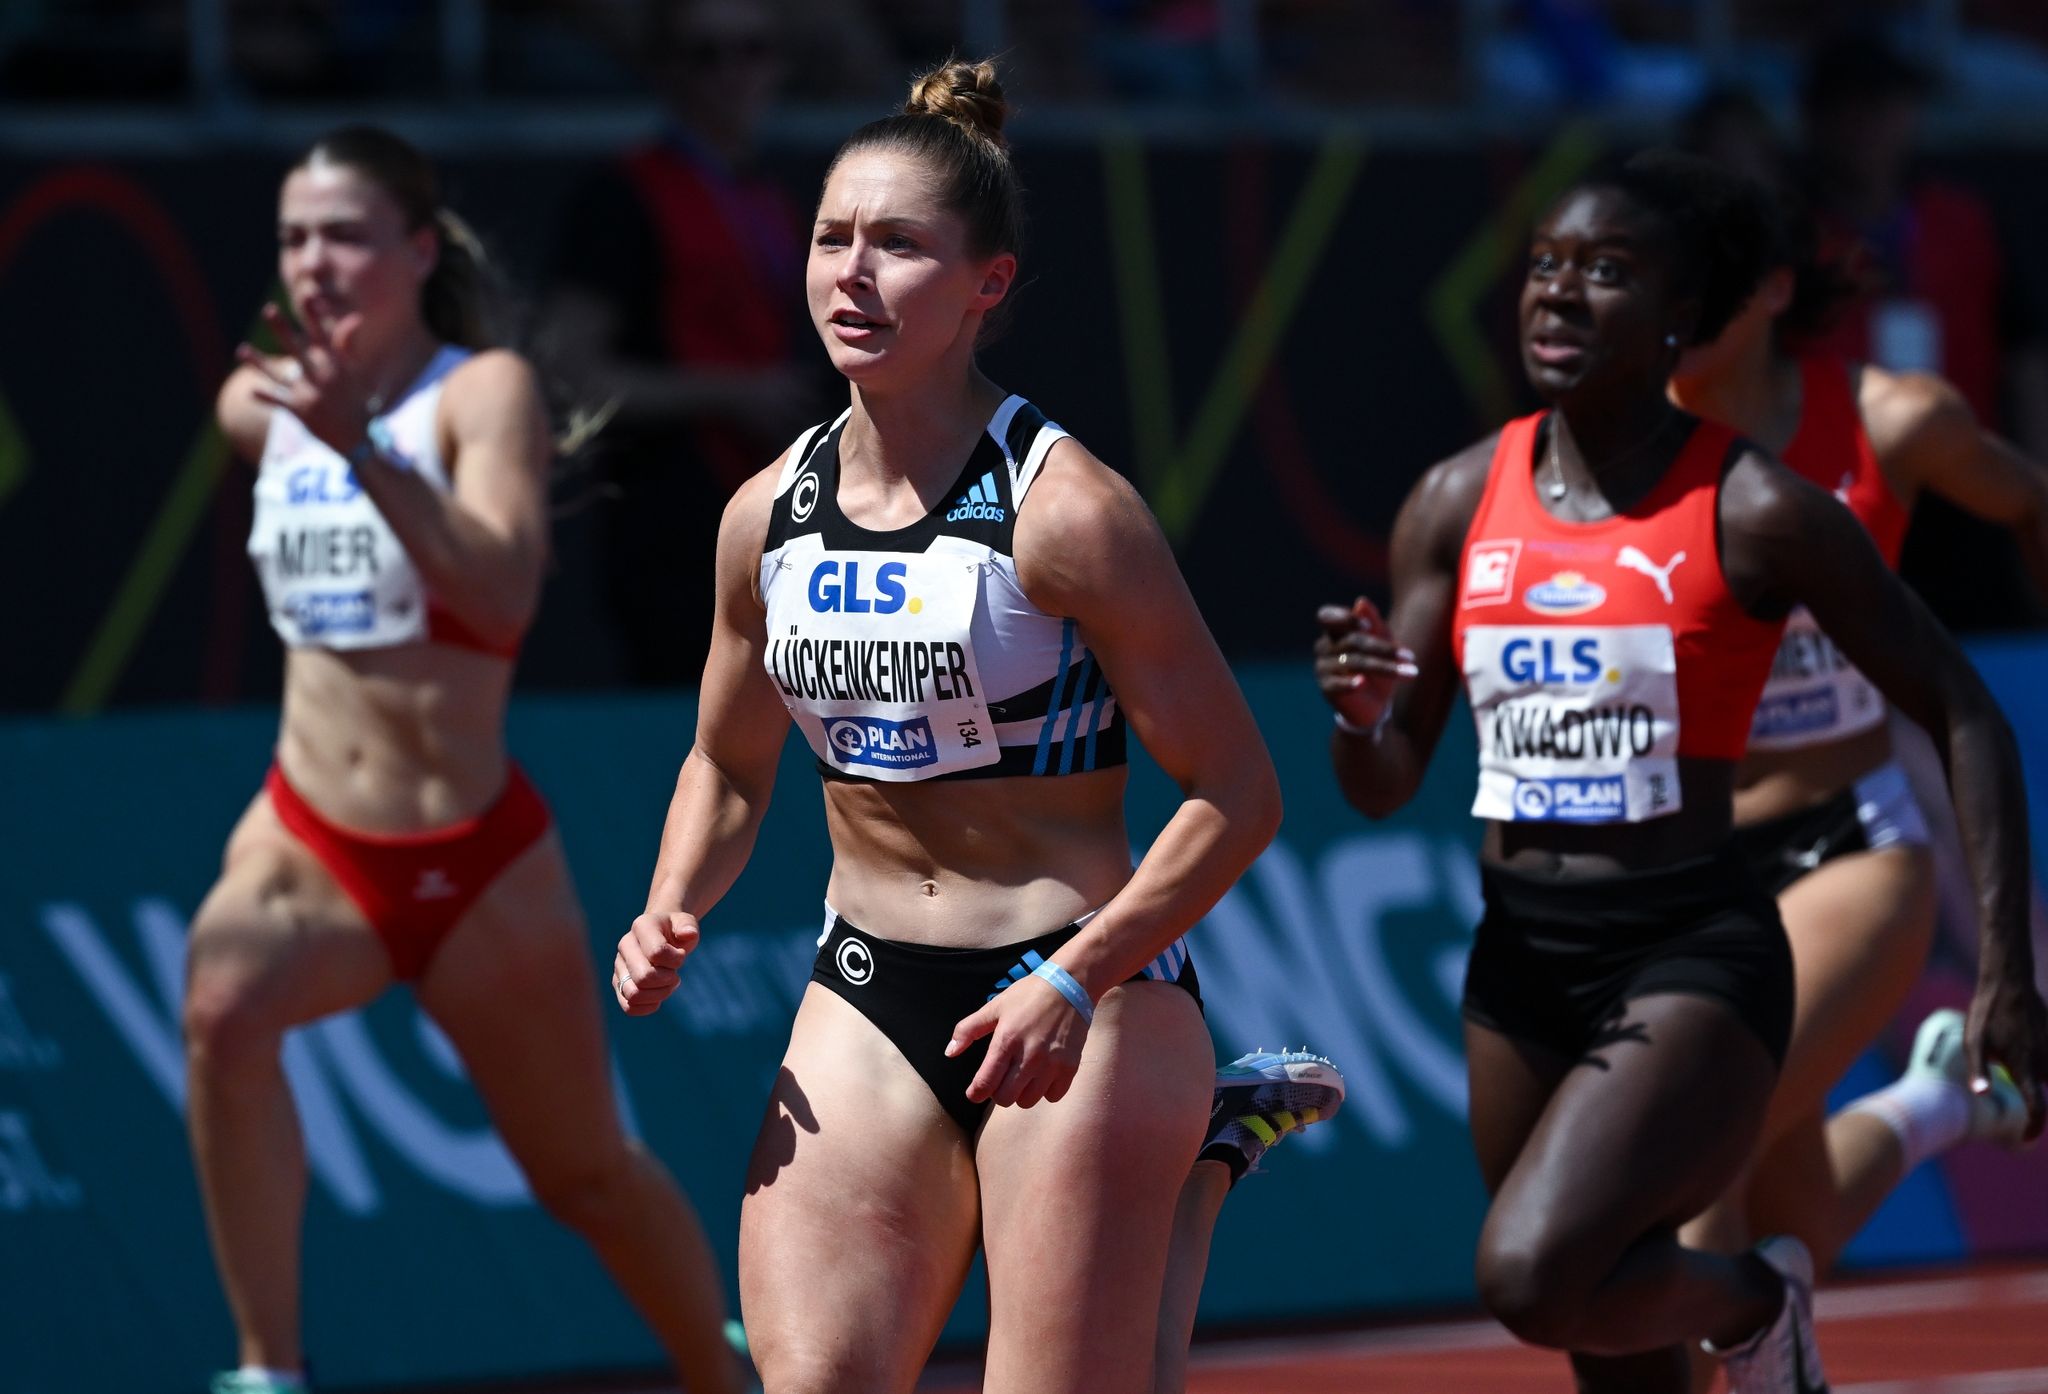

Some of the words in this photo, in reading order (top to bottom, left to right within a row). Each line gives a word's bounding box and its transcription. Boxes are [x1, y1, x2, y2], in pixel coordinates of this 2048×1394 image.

[946, 502, 1005, 523] adidas
[277, 526, 379, 577] MIER
[773, 625, 975, 703] LÜCKENKEMPER
[867, 725, 928, 751] PLAN
[956, 718, 982, 749] 134
[1494, 704, 1654, 760] KWADWO
[870, 751, 931, 763] INTERNATIONAL
[1554, 782, 1622, 807] PLAN
